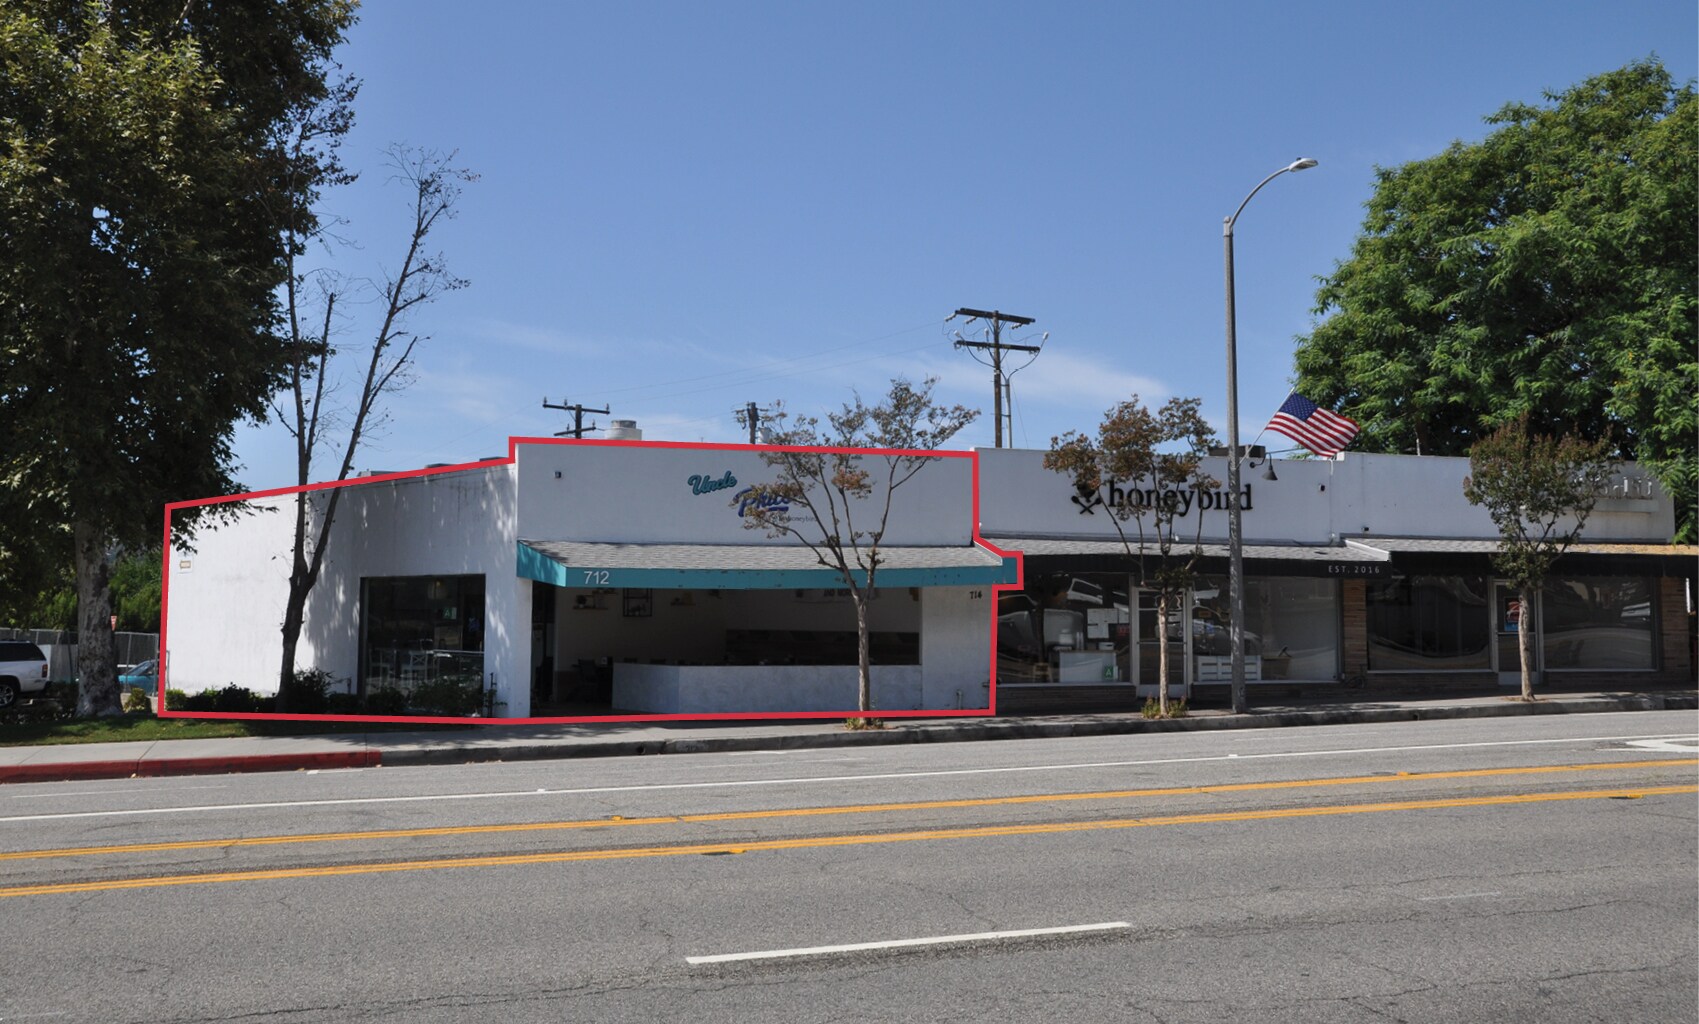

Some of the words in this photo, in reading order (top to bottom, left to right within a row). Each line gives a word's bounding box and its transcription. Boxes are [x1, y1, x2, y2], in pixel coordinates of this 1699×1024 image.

[688, 470, 737, 495] Uncle
[1109, 480, 1253, 517] honeybird
[583, 570, 610, 584] 712
[1354, 565, 1380, 574] 2016
